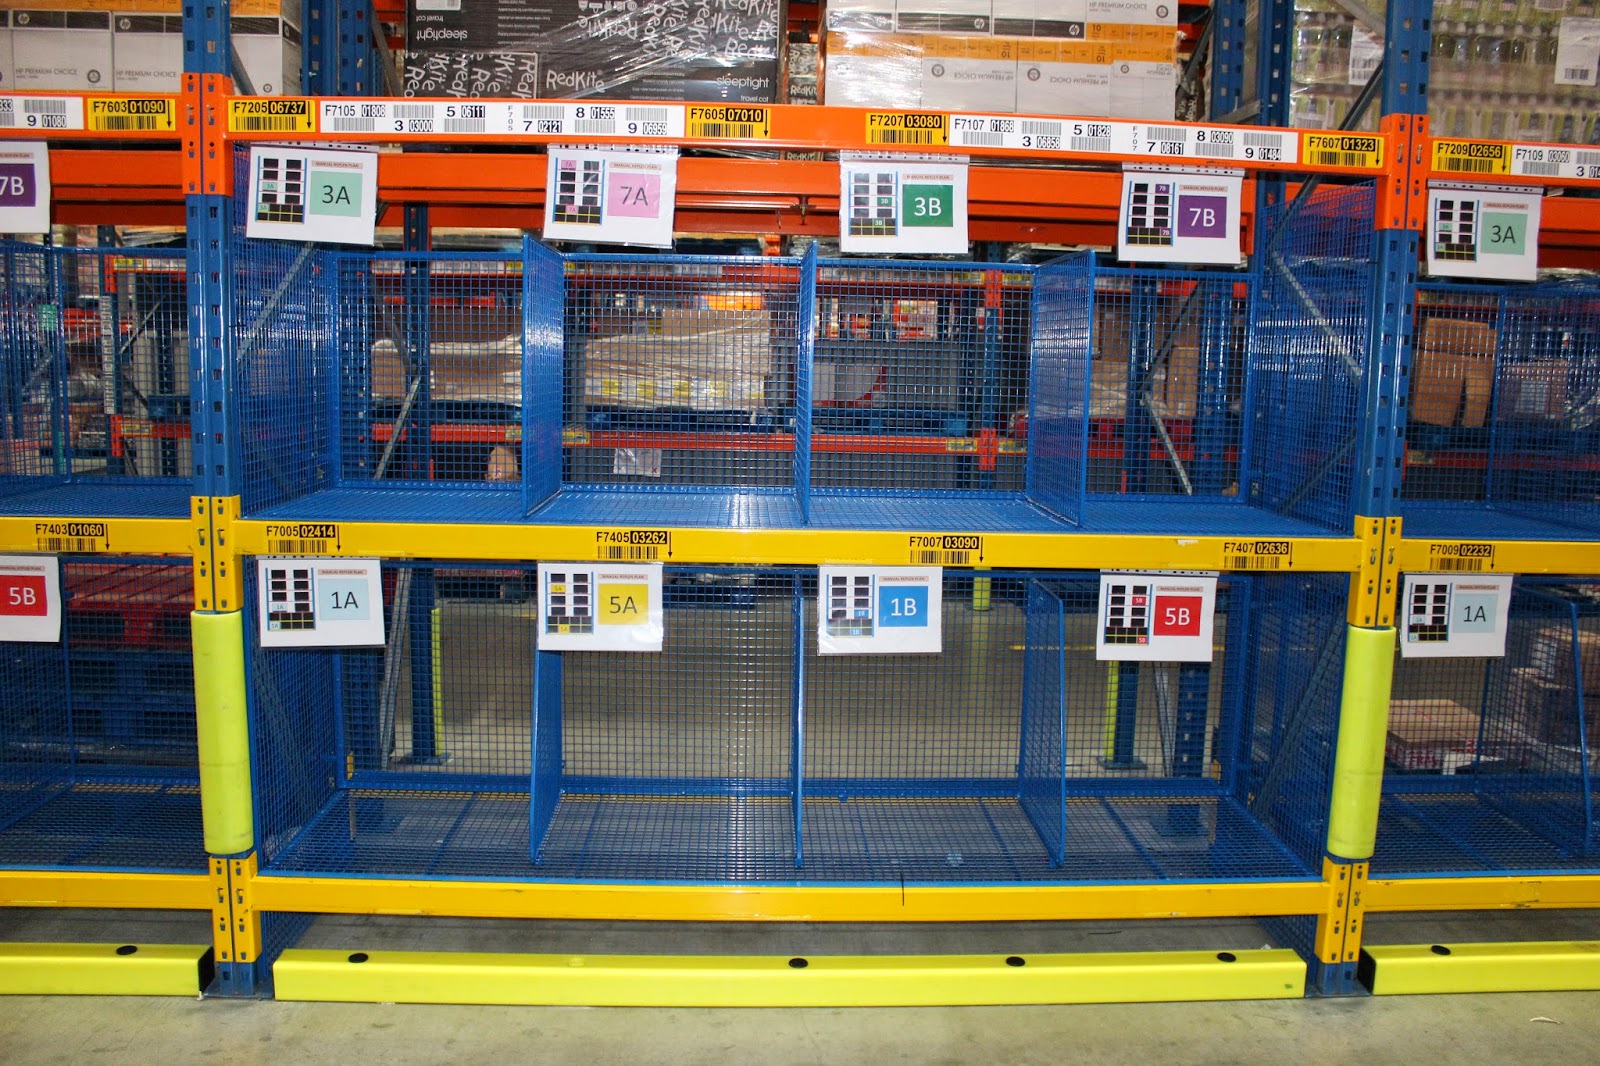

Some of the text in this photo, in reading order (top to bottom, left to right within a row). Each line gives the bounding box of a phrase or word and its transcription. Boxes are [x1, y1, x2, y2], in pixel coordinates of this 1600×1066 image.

[417, 29, 468, 41] sleeptight
[546, 69, 605, 93] RedKite
[716, 75, 769, 92] sleeptight
[93, 101, 165, 113] F7603 01090
[234, 102, 304, 114] F7205 06737
[325, 105, 356, 116] F7105
[447, 105, 486, 118] 5 06111
[576, 107, 615, 119] 8 01555
[27, 115, 37, 126] 9
[691, 108, 762, 121] F7605 07010
[394, 120, 433, 132] 3 03000
[523, 120, 562, 133] 7 02121
[870, 115, 941, 128] F7207 03080
[955, 118, 984, 130] F7107
[628, 122, 637, 134] 9
[1073, 124, 1082, 135] 5
[1022, 136, 1031, 147] 3
[1197, 131, 1205, 141] 8
[1147, 142, 1156, 152] 7
[1309, 136, 1374, 151] F7607 01323
[1245, 148, 1253, 158] 9
[1438, 143, 1502, 157] F7209 02656
[1516, 149, 1543, 161] F7109
[1576, 166, 1585, 177] 3
[0, 176, 24, 196] 7B
[322, 185, 351, 205] 3A
[620, 186, 648, 206] 7A
[914, 197, 942, 217] 3B
[1189, 208, 1216, 227] 7B
[1490, 225, 1516, 244] 3A
[36, 524, 103, 535] F7403 01060
[266, 526, 334, 537] F7005 02414
[596, 532, 666, 544] F7405 03262
[909, 536, 978, 549] F7007 03090
[1224, 542, 1287, 554] F7407 02636
[1430, 544, 1490, 556] F7009 02232
[9, 587, 36, 605] 5B
[331, 591, 359, 609] 1A
[609, 596, 638, 614] 5A
[890, 598, 917, 617] 1B
[1164, 608, 1190, 626] 5B
[1463, 605, 1487, 622] 1A
